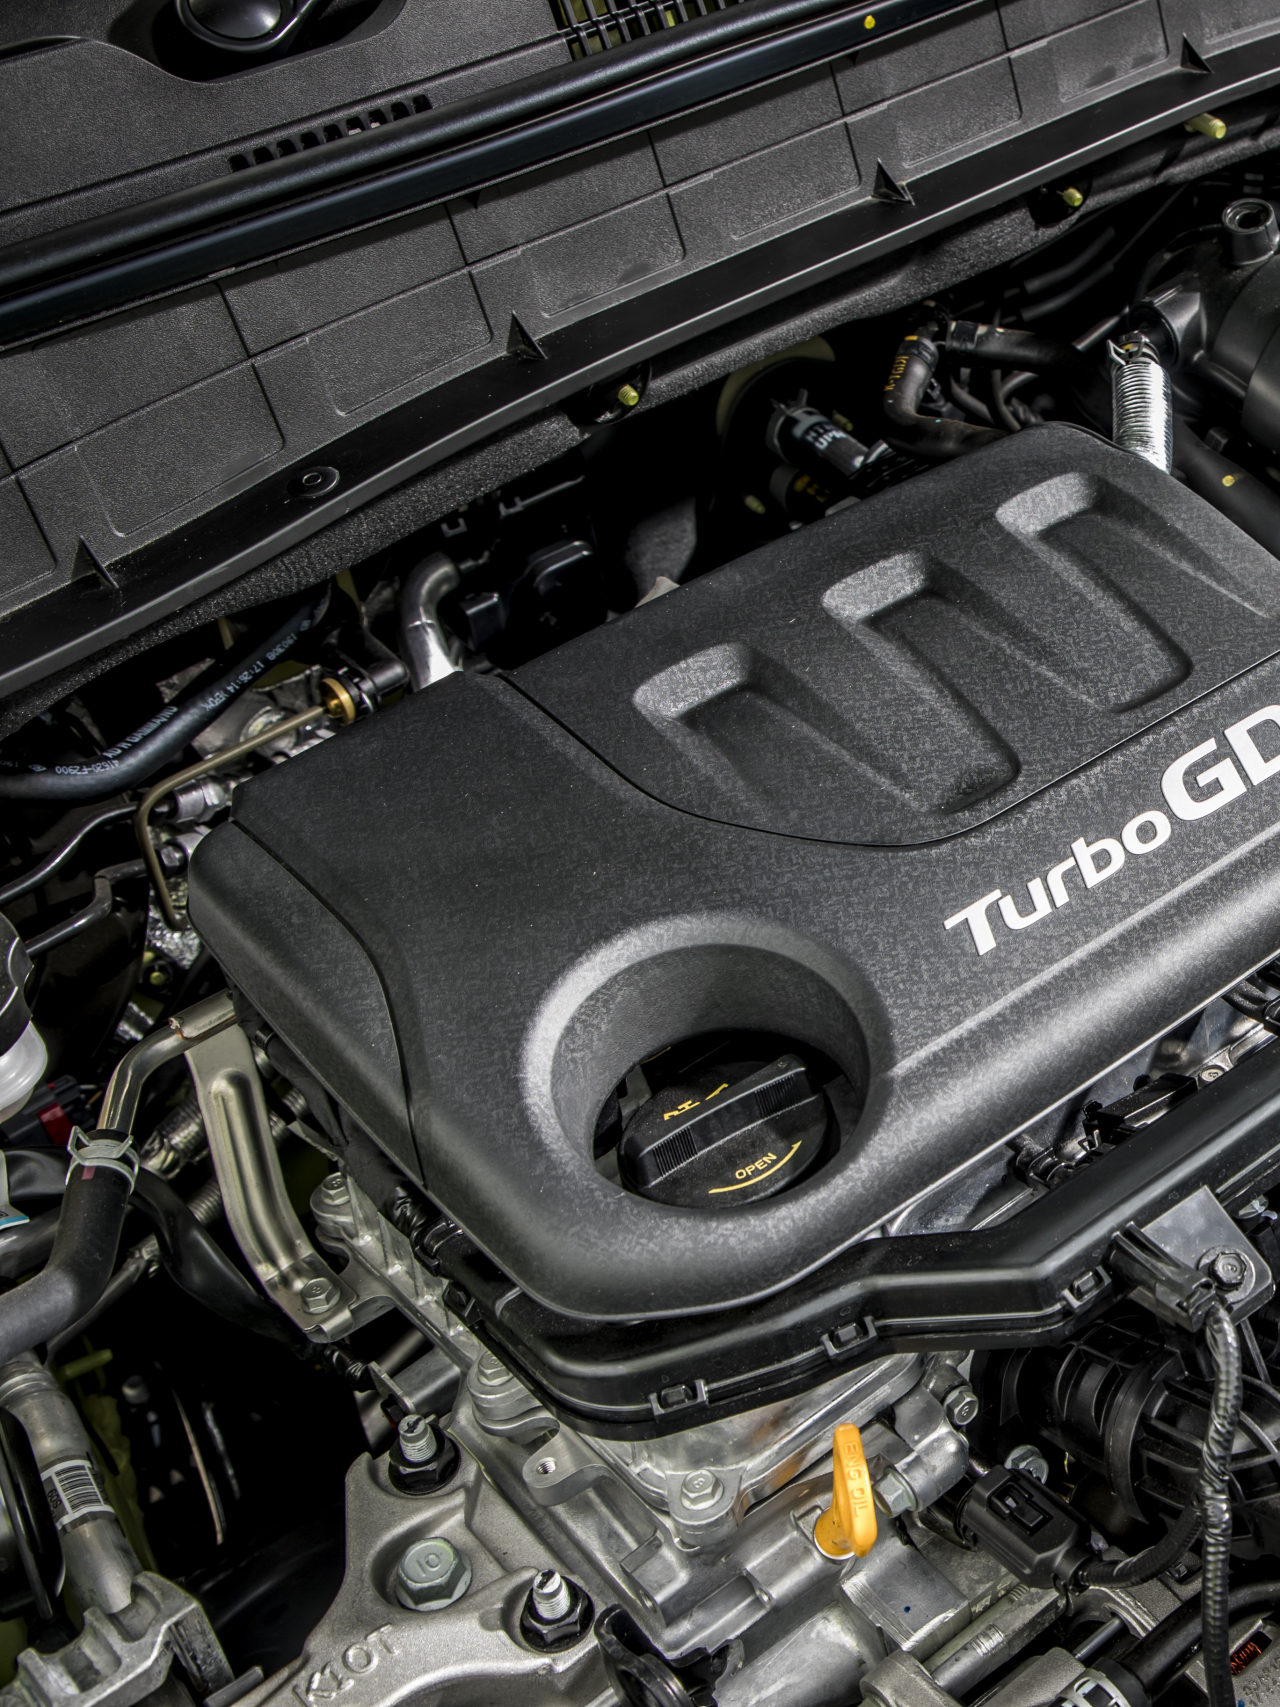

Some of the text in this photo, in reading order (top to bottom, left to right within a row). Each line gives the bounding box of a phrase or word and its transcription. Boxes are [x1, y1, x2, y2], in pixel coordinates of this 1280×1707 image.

[735, 1152, 777, 1180] OPEN
[844, 1441, 869, 1518] ENG OIL
[416, 1553, 441, 1577] 10
